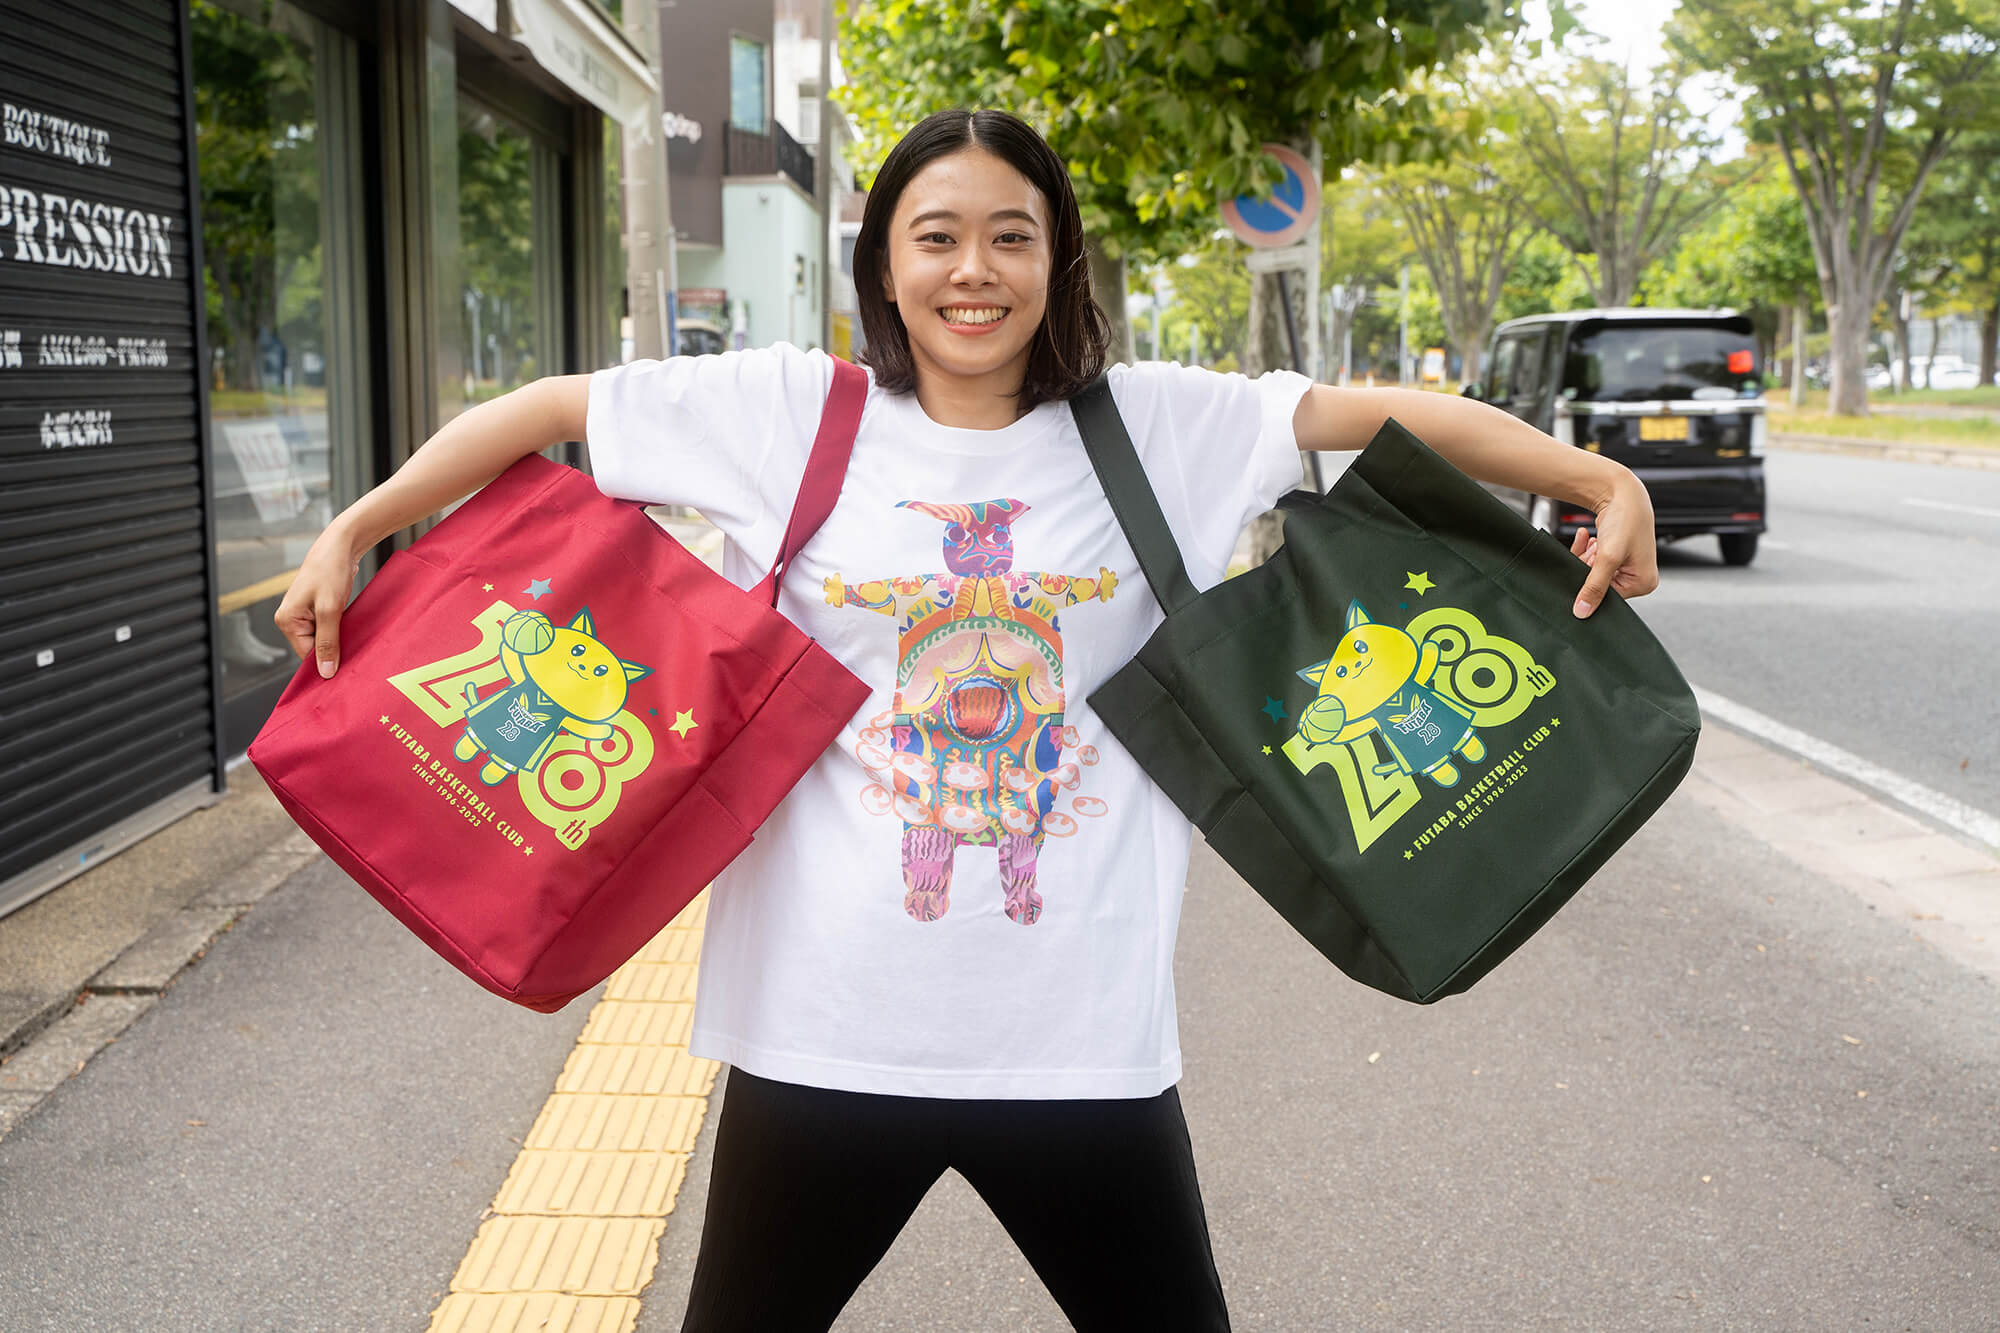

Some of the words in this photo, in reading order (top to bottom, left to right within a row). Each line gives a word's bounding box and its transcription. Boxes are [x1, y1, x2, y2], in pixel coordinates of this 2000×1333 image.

[4, 103, 112, 168] BOUTIQUE
[496, 719, 521, 742] 28
[507, 697, 546, 733] FUTABA
[1393, 698, 1432, 734] FUTABA
[1417, 722, 1441, 746] 28
[389, 723, 431, 762] FUTABA
[429, 760, 496, 822] BASKETBALL
[496, 820, 524, 847] CLUB
[412, 763, 436, 786] SINCE
[436, 785, 481, 827] 1996-2023
[1413, 810, 1457, 851] FUTABA
[1456, 750, 1524, 812] BASKETBALL
[1522, 726, 1551, 752] CLUB
[1458, 805, 1483, 829] SINCE
[1483, 764, 1529, 807] 1996-2023
